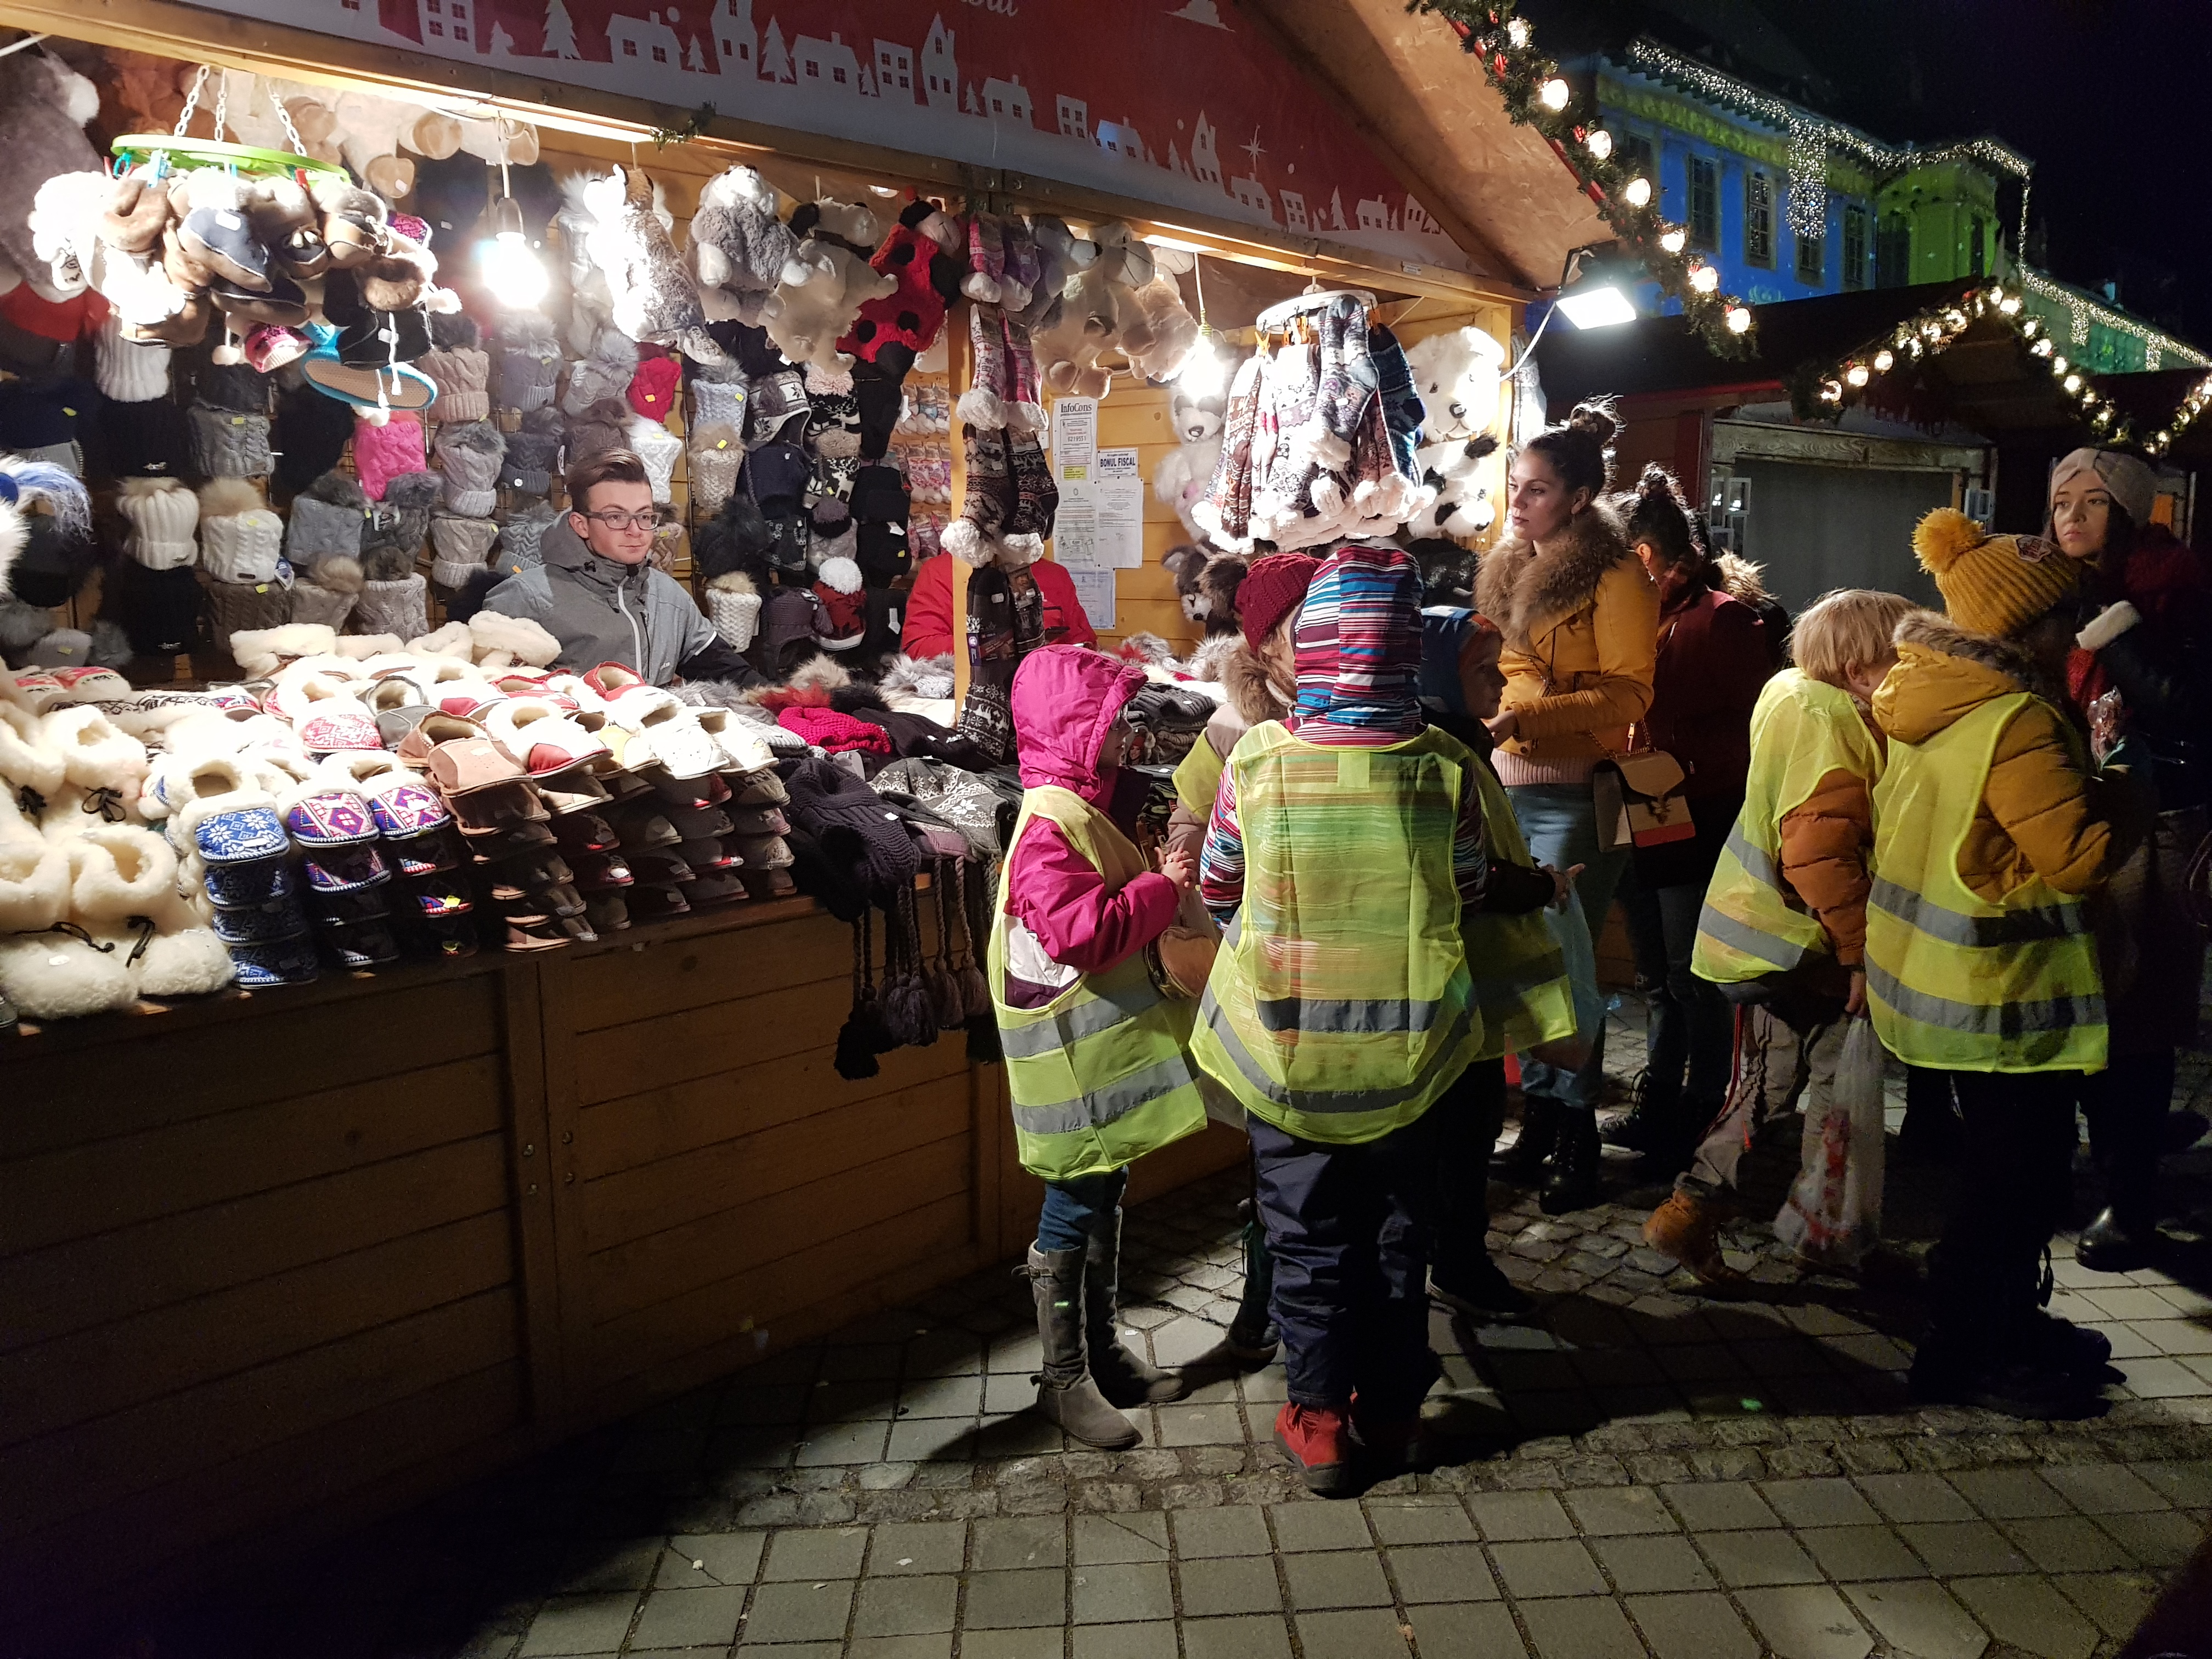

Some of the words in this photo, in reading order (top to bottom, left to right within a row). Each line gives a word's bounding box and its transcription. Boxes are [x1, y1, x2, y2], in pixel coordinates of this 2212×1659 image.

[1061, 403, 1092, 413] InfoCons
[1100, 458, 1117, 467] BONUL
[1118, 457, 1136, 466] FISCAL
